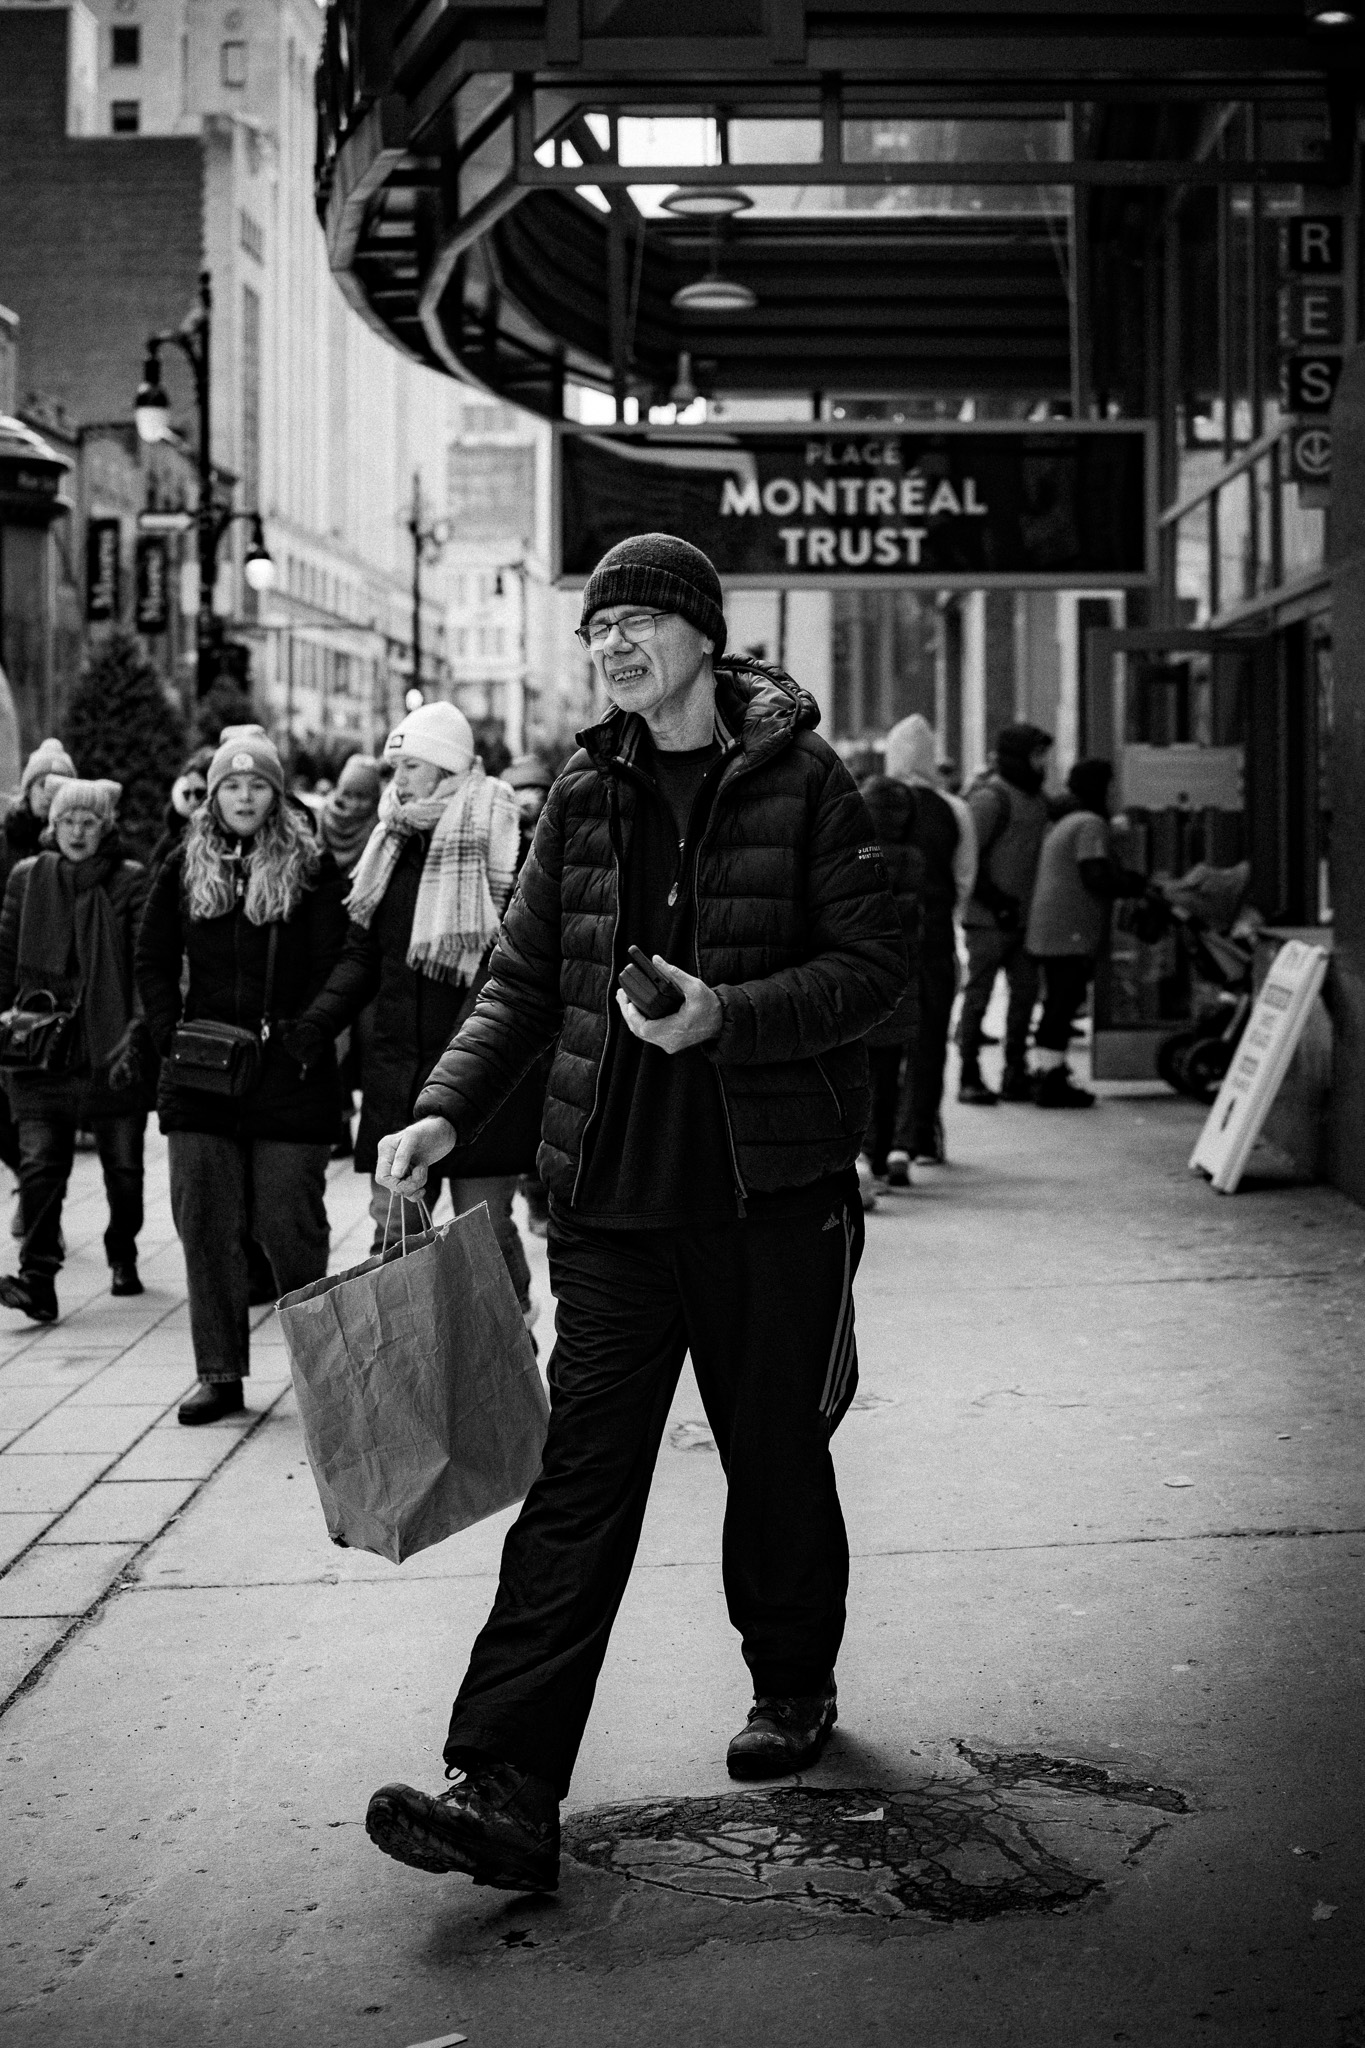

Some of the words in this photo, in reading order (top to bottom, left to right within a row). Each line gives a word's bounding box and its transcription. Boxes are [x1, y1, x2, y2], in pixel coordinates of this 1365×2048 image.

[804, 442, 900, 466] PLACE
[720, 466, 988, 516] MONTRÉAL
[778, 527, 928, 566] TRUST
